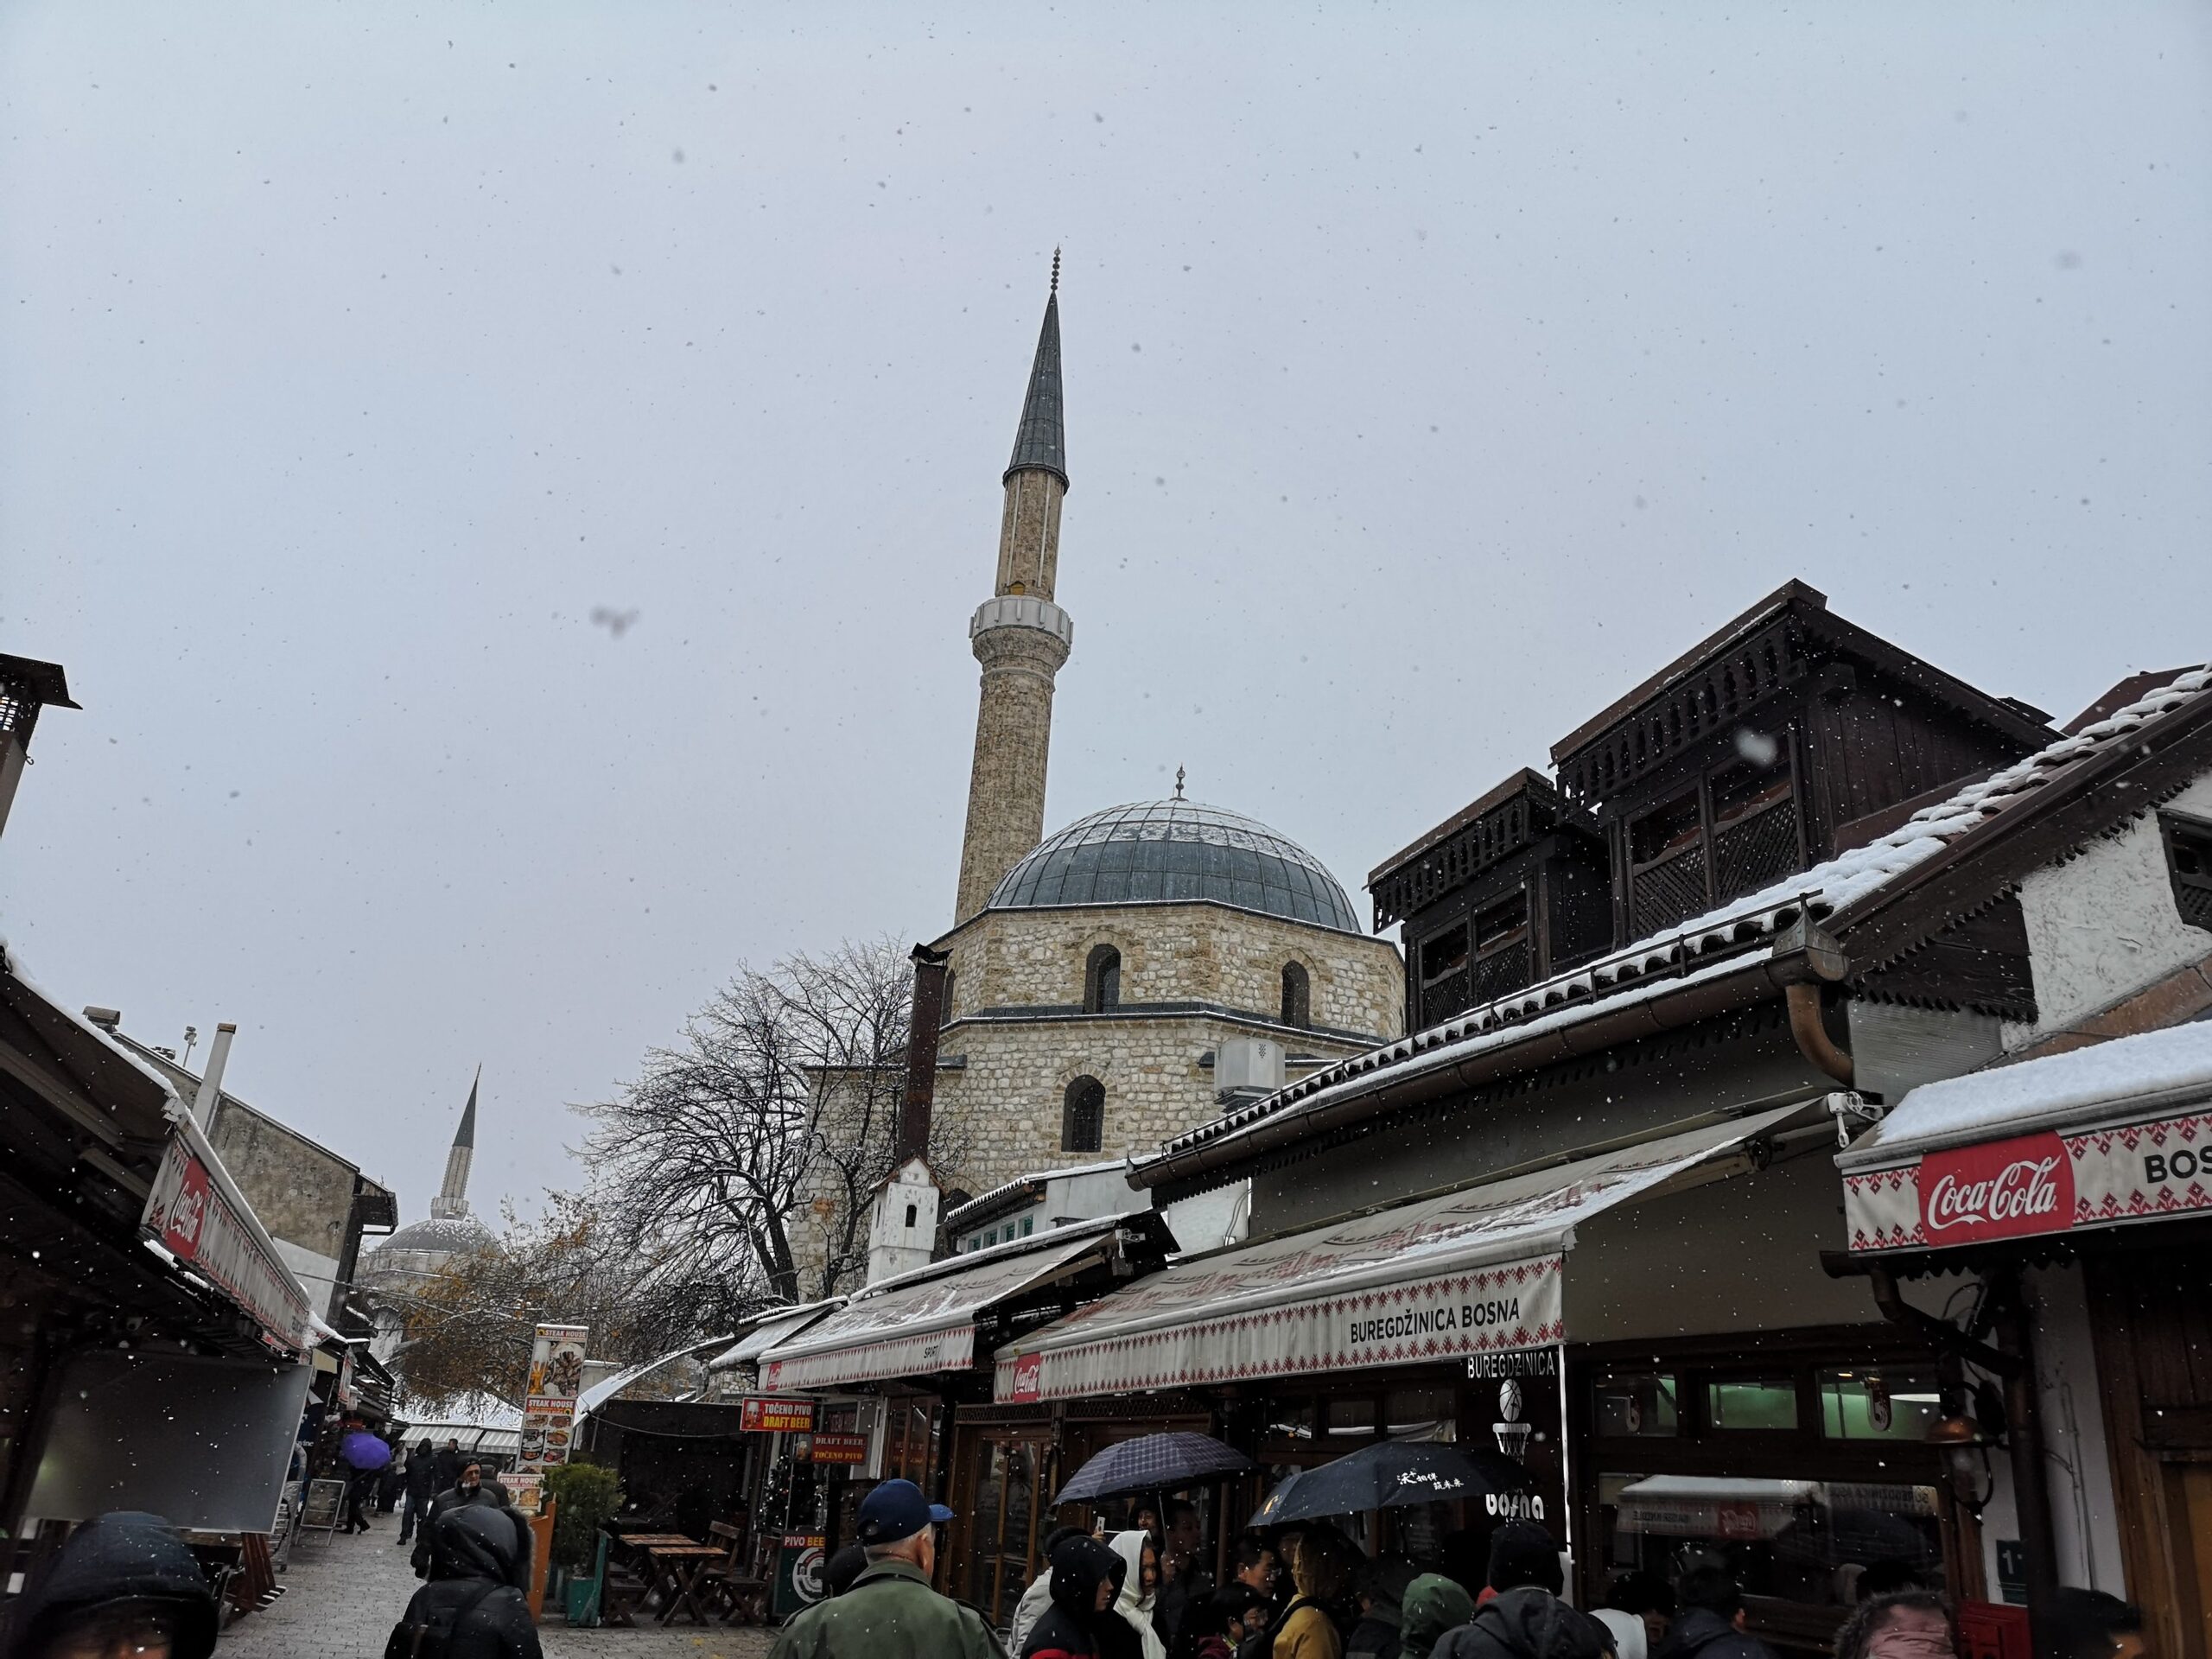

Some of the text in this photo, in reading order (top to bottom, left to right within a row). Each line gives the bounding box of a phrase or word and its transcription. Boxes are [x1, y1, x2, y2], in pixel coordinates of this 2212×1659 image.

[1928, 1154, 2062, 1230] Coca-Cola
[1351, 1297, 1520, 1344] BUREGDŽINICA BOSNA
[528, 1399, 575, 1408] STEAK HOUSE
[764, 1402, 812, 1416] TOČENO PIVO
[763, 1416, 810, 1429] DRAFT BEER
[815, 1437, 841, 1446] DRAFT
[814, 1450, 862, 1460] TOČENO PIVO
[784, 1536, 825, 1547] PIVO BEE
